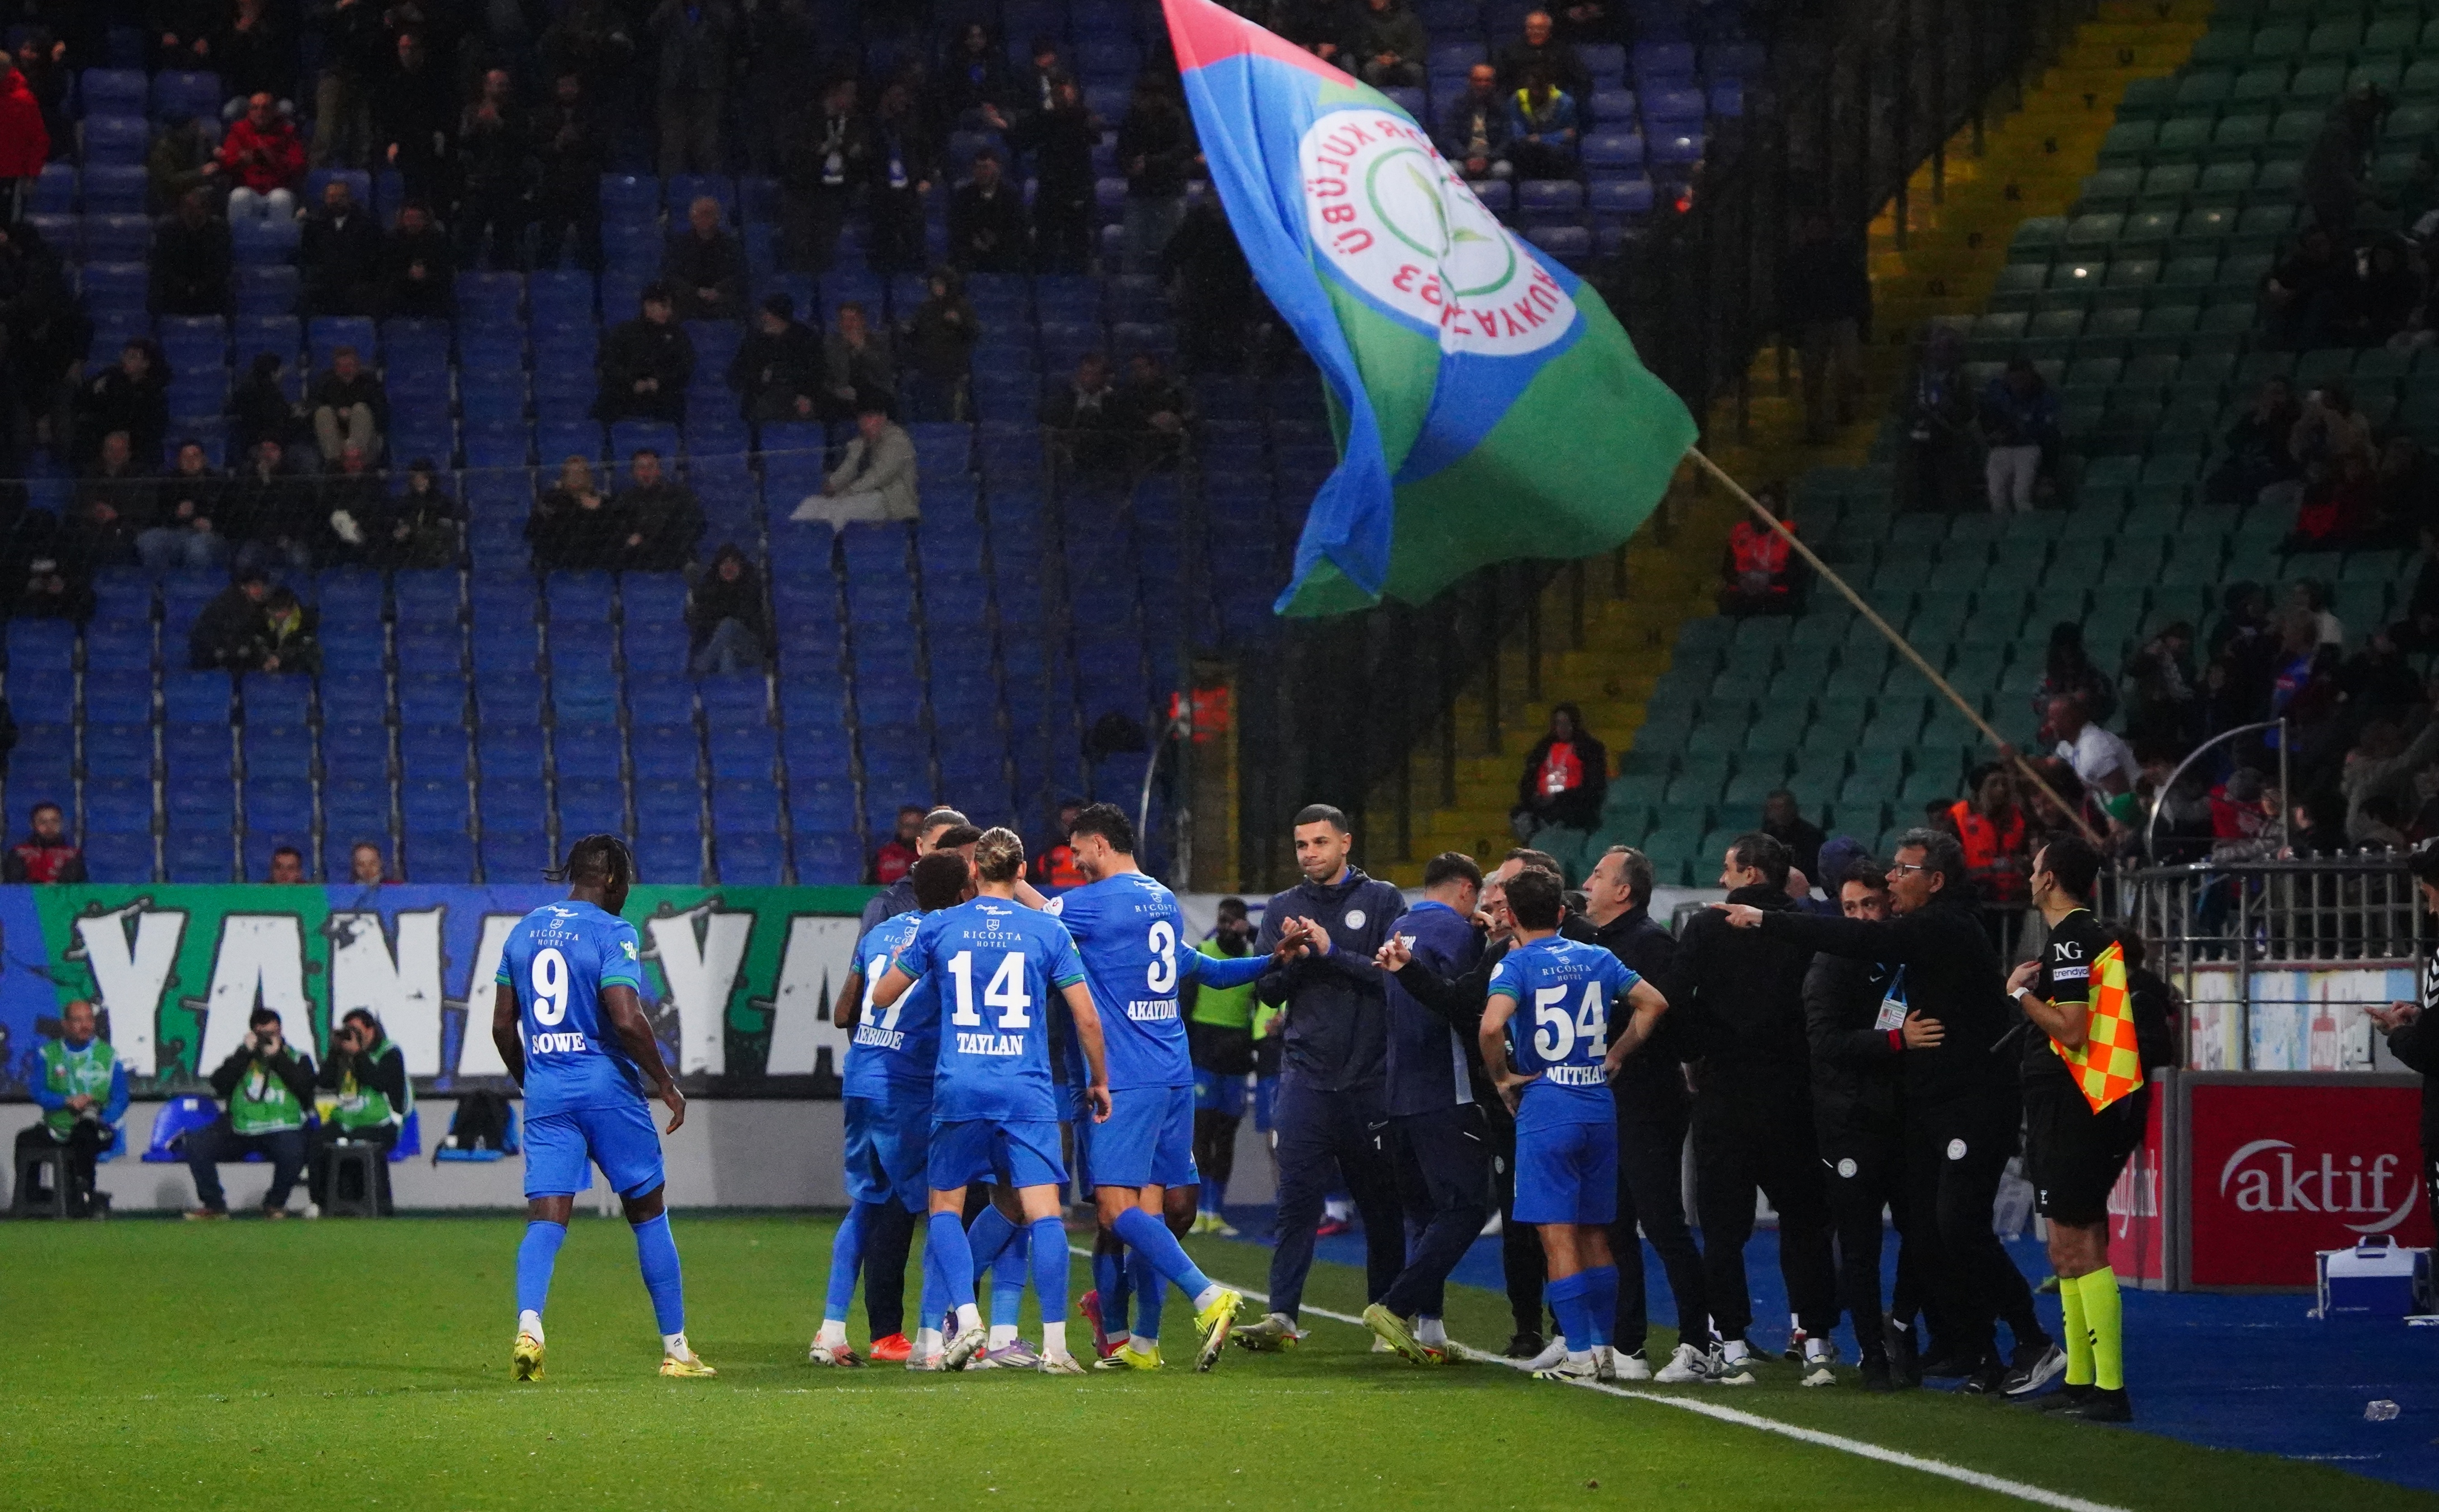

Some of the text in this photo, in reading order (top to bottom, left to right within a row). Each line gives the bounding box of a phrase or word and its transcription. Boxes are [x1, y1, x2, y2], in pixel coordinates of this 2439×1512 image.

[2119, 48, 2134, 66] U
[2083, 93, 2097, 109] T
[529, 929, 579, 942] RICOSTA
[537, 938, 564, 947] HOTEL
[883, 934, 908, 944] RICO
[963, 930, 1022, 941] RICOSTA
[1147, 920, 1177, 994] 3
[2053, 941, 2084, 961] NG
[1542, 964, 1592, 976] RICOSTA
[532, 948, 569, 1026] 9
[948, 951, 1031, 1028] 14
[1534, 981, 1608, 1061] 54
[532, 1032, 586, 1055] SOWE
[957, 1032, 1024, 1055] TAYLAN
[1374, 1135, 1381, 1149] 1
[2237, 1153, 2398, 1213] aktif
